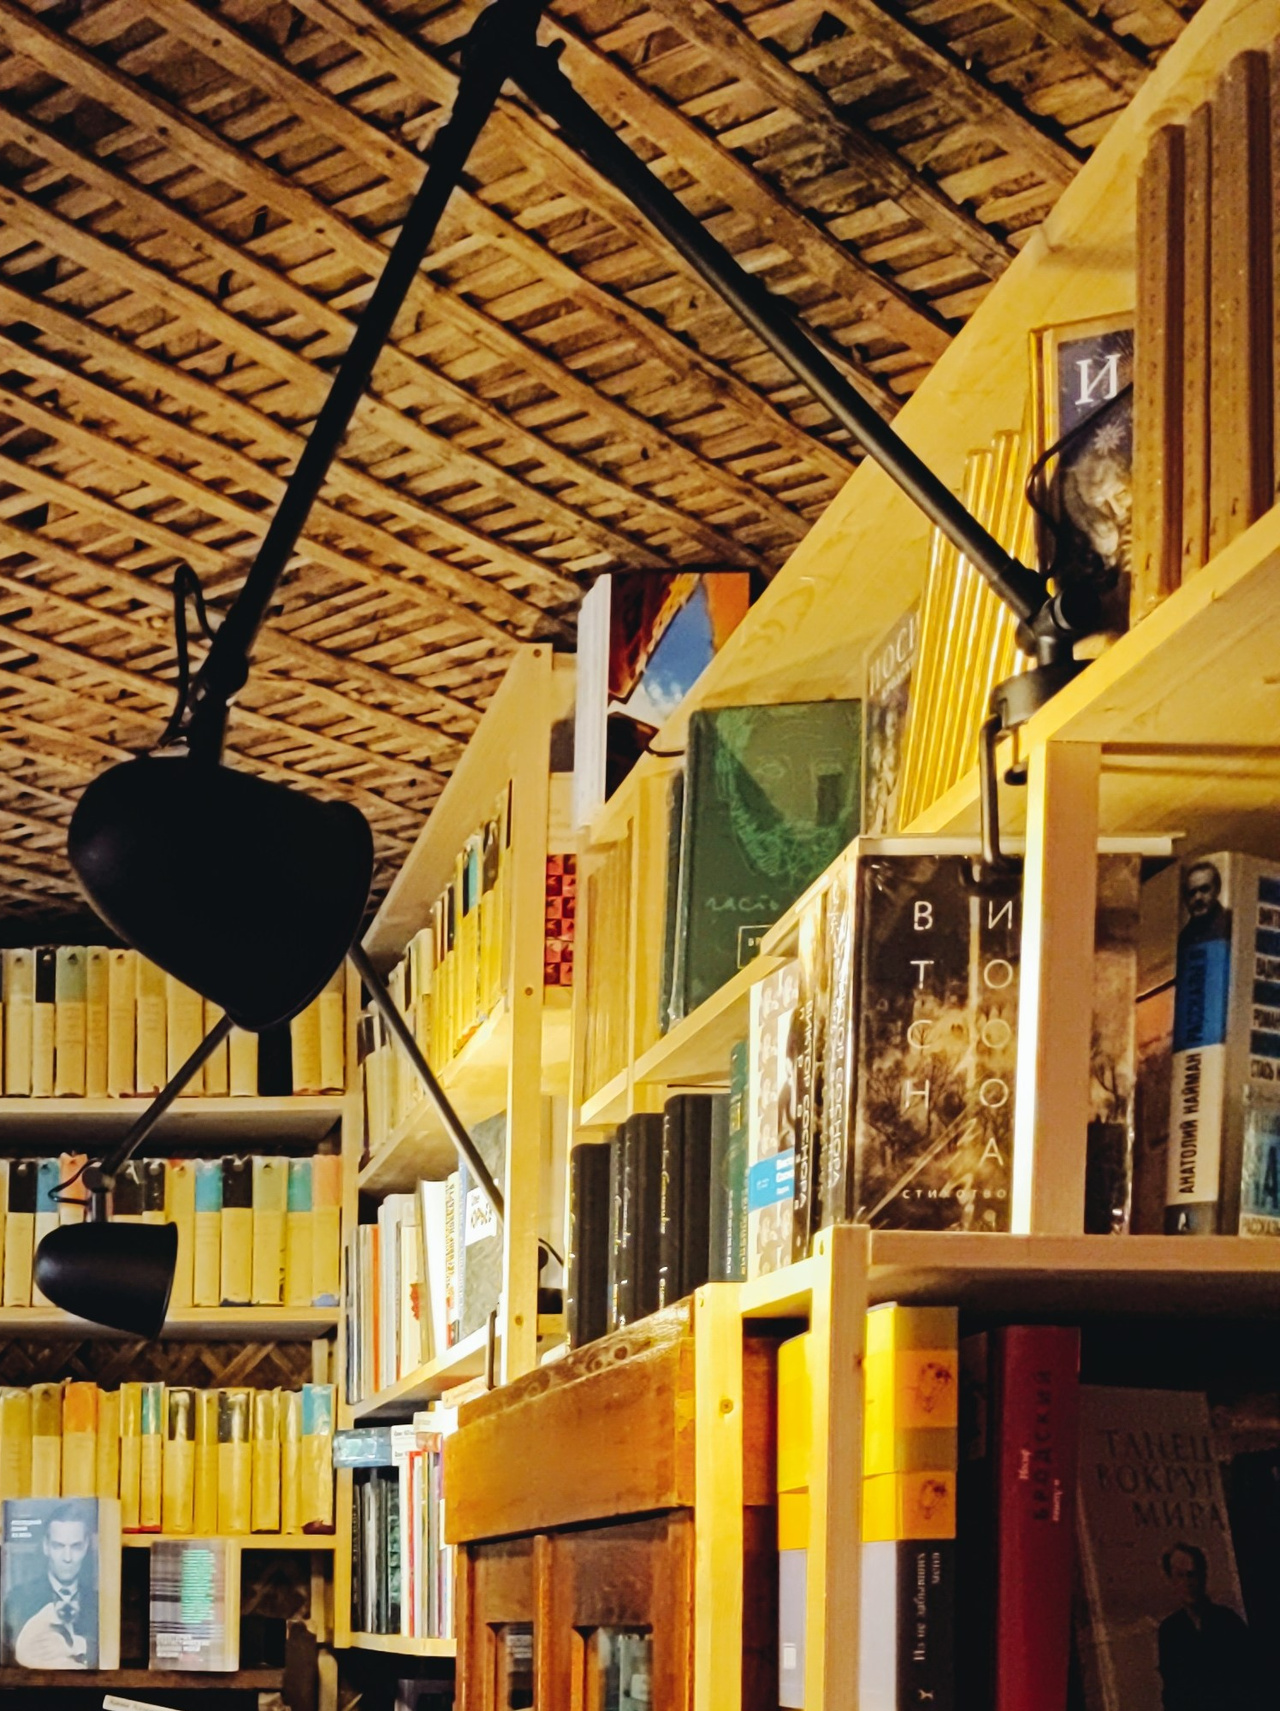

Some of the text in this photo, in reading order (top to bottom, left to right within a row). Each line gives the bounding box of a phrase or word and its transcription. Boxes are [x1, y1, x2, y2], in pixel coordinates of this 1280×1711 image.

[1183, 1053, 1202, 1113] НАЙМАН
[1179, 1119, 1199, 1195] АНАТОЛИЙ
[902, 1189, 1007, 1199] СТИХОТВО
[1034, 1370, 1051, 1520] БРОДСКИЙ
[1102, 1429, 1212, 1462] ТАНЕЦ
[1097, 1463, 1213, 1497] ВОКРУГ
[1132, 1501, 1225, 1531] МИРА
